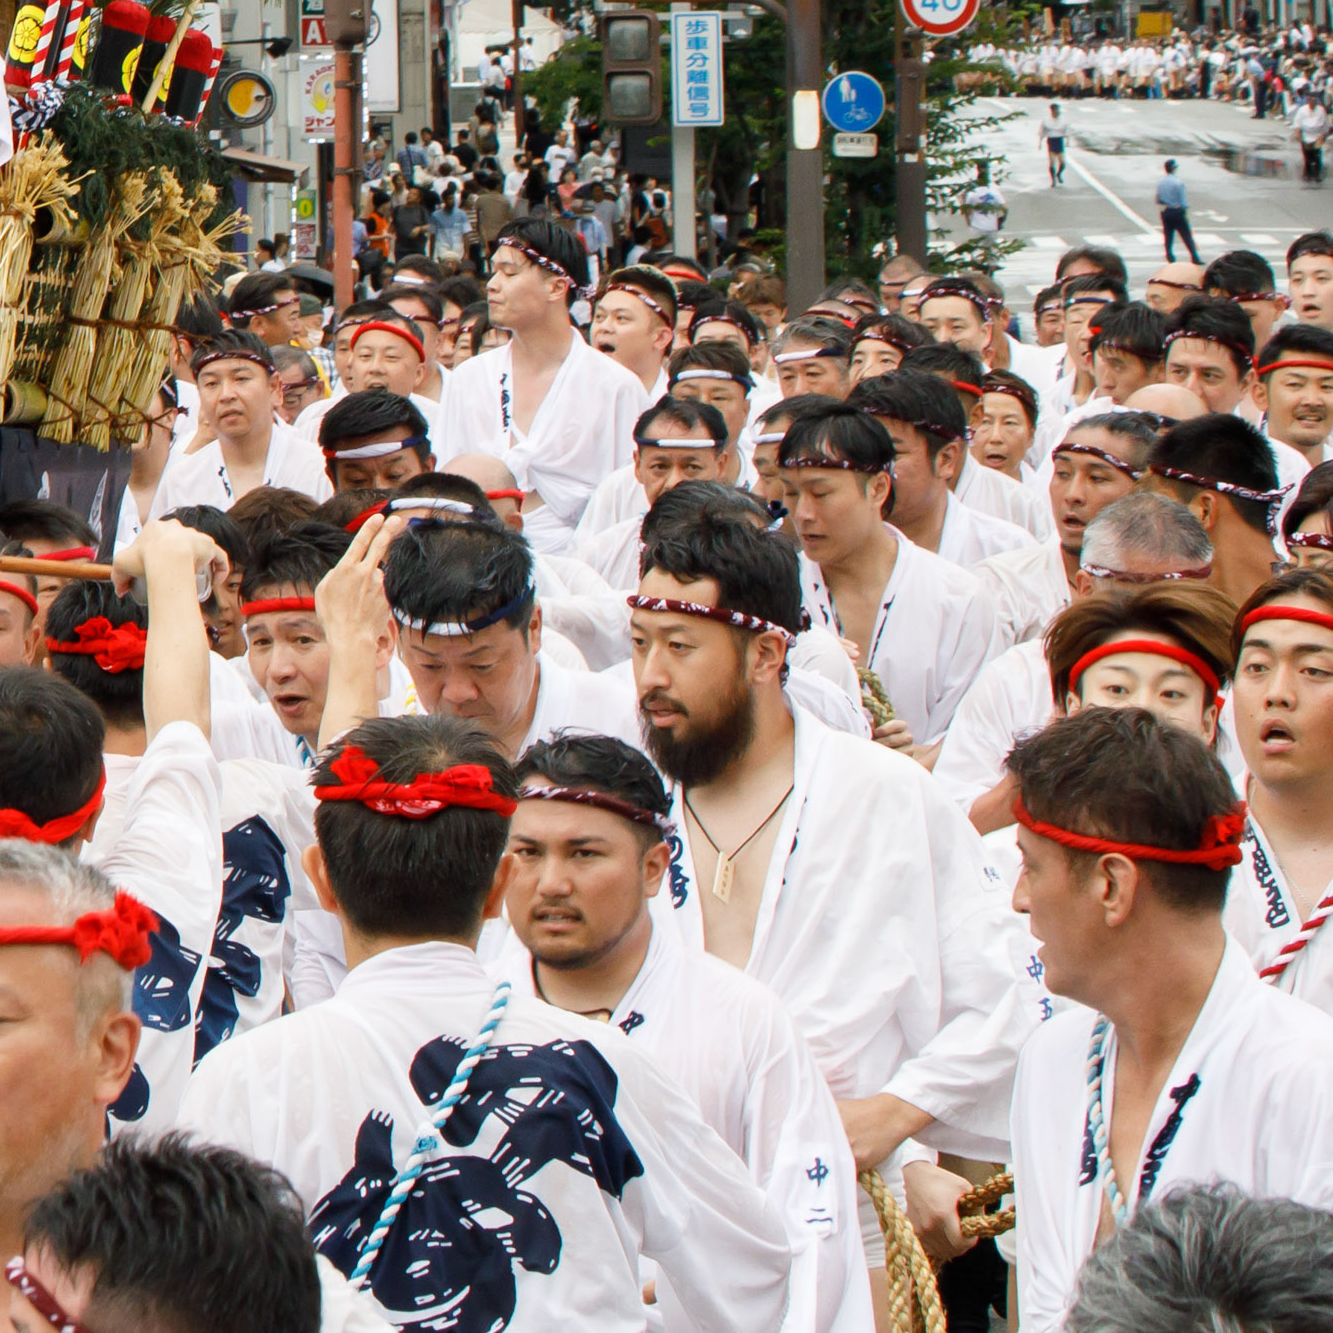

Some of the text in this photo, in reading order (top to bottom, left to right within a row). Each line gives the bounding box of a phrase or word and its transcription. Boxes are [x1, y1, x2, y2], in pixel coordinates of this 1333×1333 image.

[685, 19, 710, 118] 歩車分離信号
[805, 1156, 833, 1223] 中二
